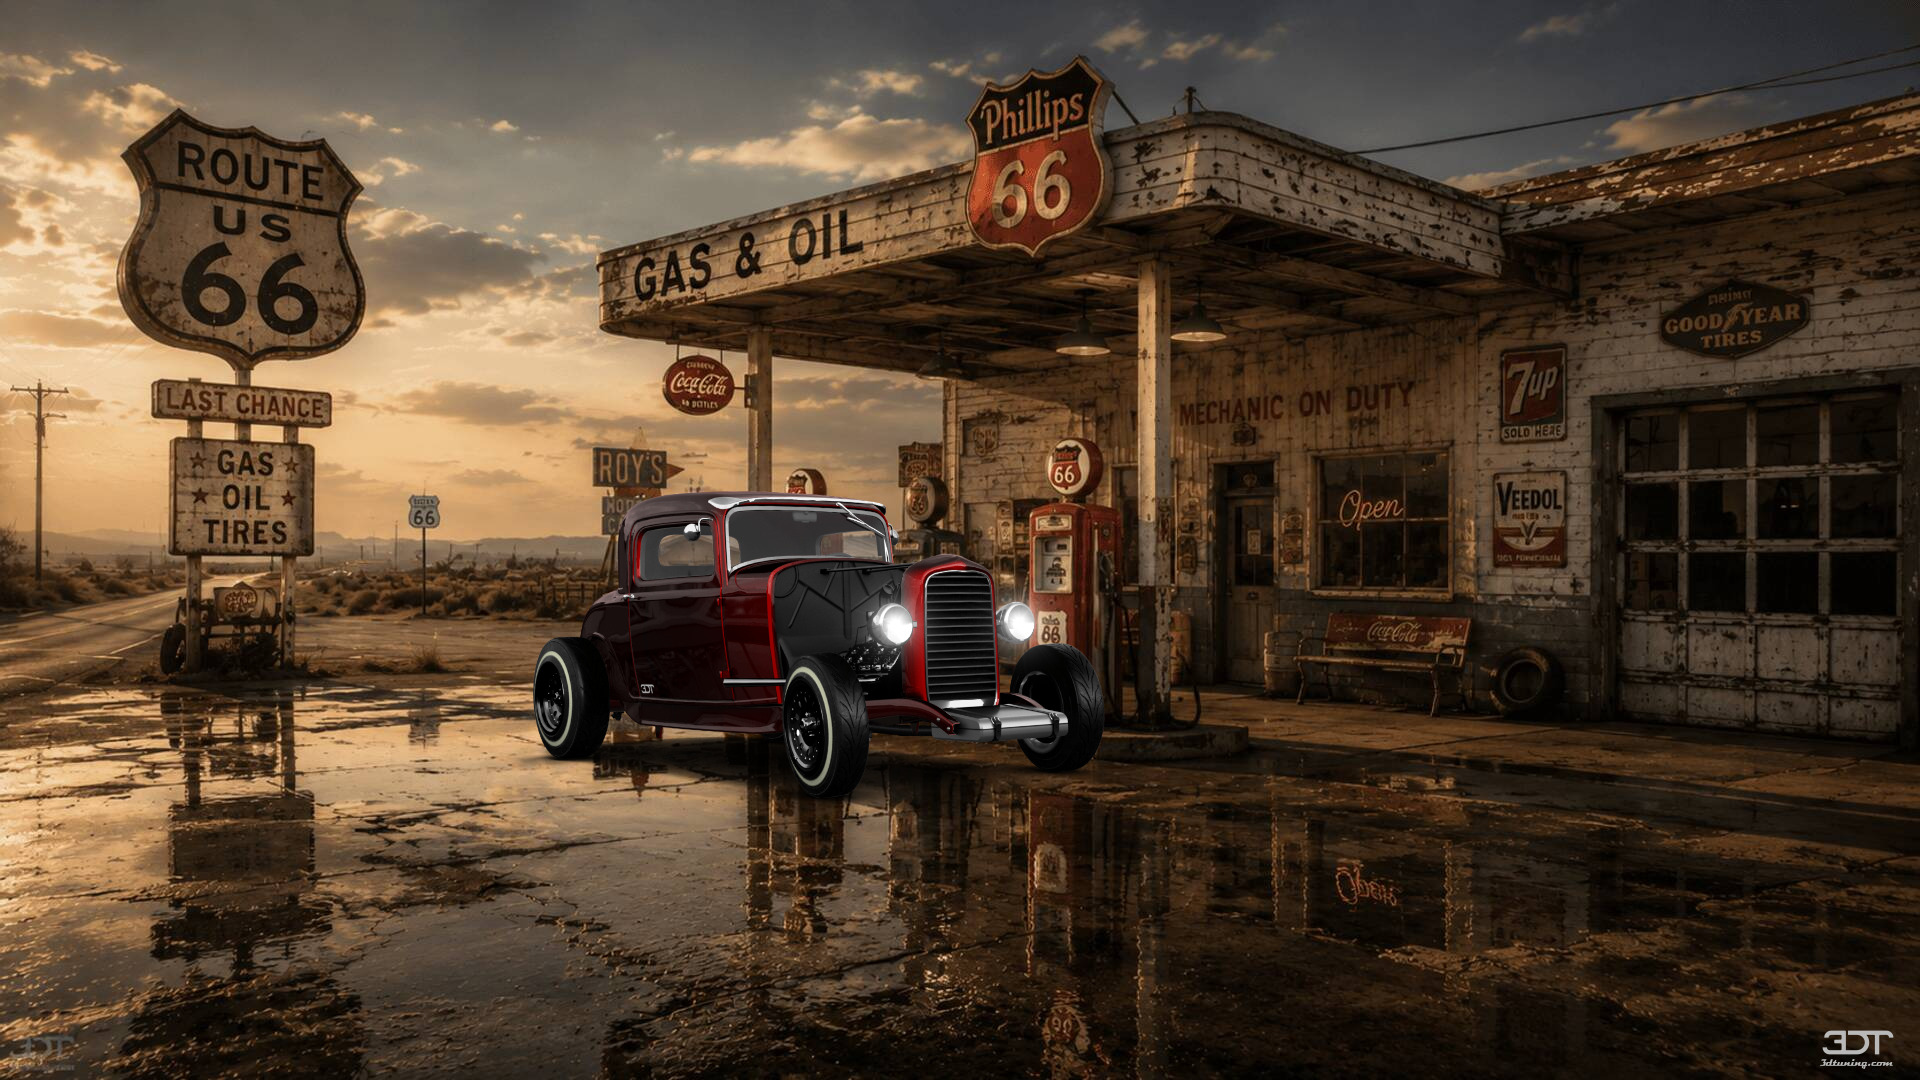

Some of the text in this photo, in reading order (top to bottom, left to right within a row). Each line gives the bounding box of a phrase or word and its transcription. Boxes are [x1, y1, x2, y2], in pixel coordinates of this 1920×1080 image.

[979, 89, 1085, 144] Phillips
[177, 141, 323, 200] ROUTE
[990, 149, 1072, 229] 66
[213, 205, 292, 243] US
[633, 209, 864, 301] GAS & OIL
[181, 241, 319, 335] 66
[1700, 330, 1763, 349] TIRES
[165, 388, 325, 419] LAST CHANCE
[1178, 381, 1415, 427] MECHANIC ON DUTY
[1503, 425, 1562, 439] SOLD HERE
[217, 449, 275, 477] GAS
[599, 451, 663, 485] ROY'S
[1054, 465, 1075, 484] 66
[222, 484, 271, 511] OIL
[1338, 489, 1405, 531] Open
[1496, 481, 1563, 516] VEEDOL
[202, 518, 288, 545] TIRES
[414, 510, 435, 525] 66
